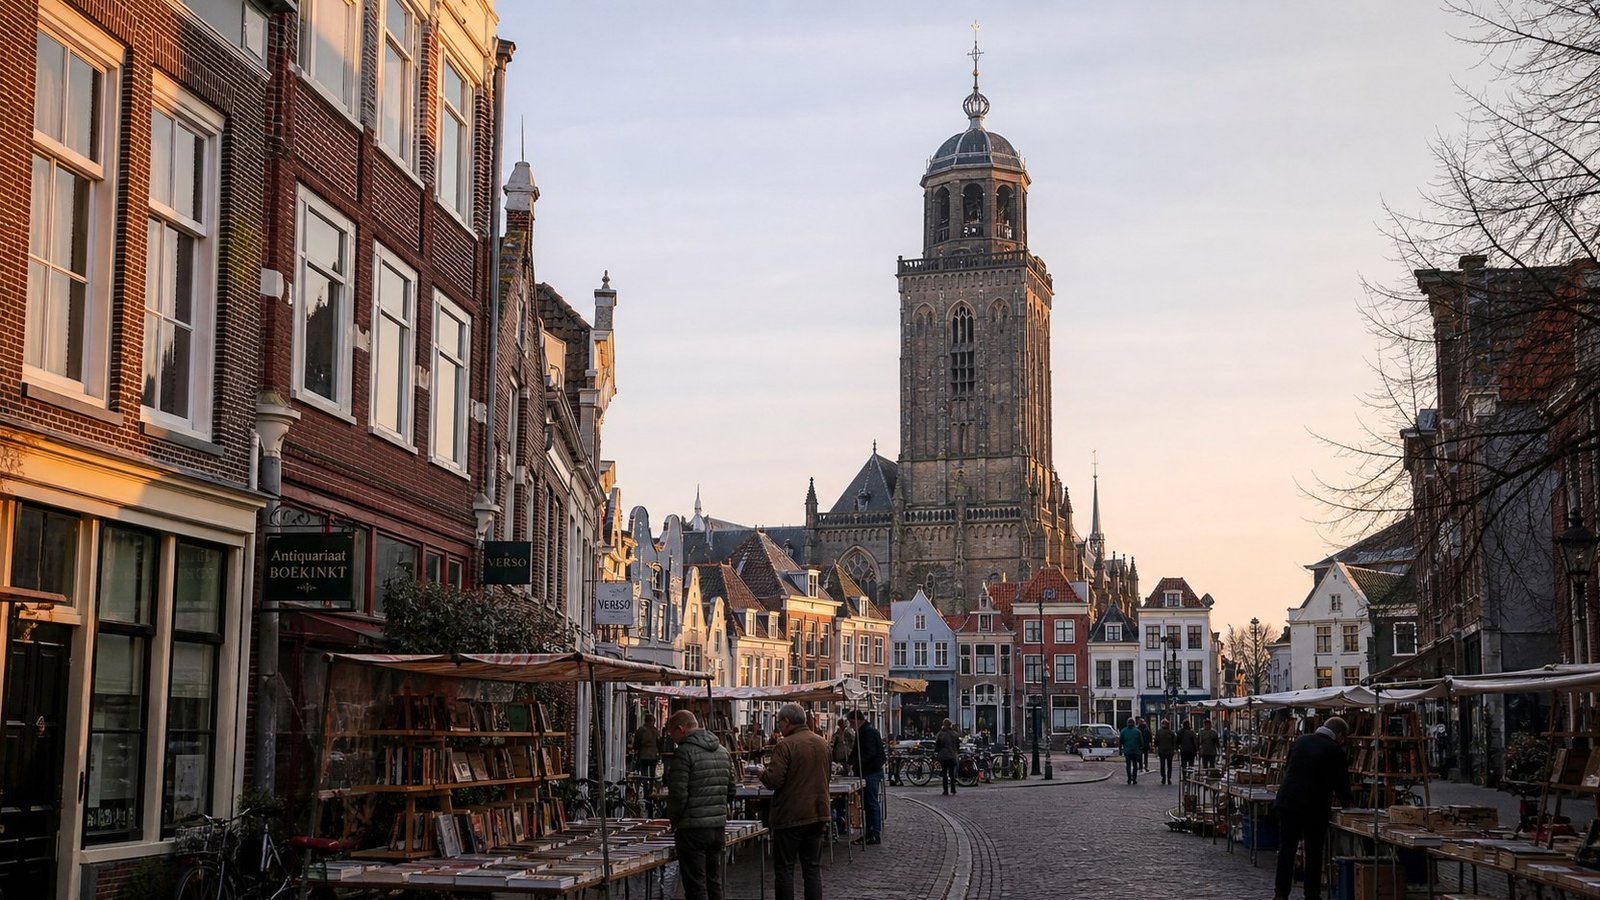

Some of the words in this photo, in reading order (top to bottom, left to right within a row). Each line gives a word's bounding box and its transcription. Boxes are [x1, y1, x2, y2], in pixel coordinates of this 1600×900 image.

[270, 549, 347, 565] Antiquariaat
[487, 557, 527, 568] VERSO
[269, 566, 348, 579] BOEKINKT
